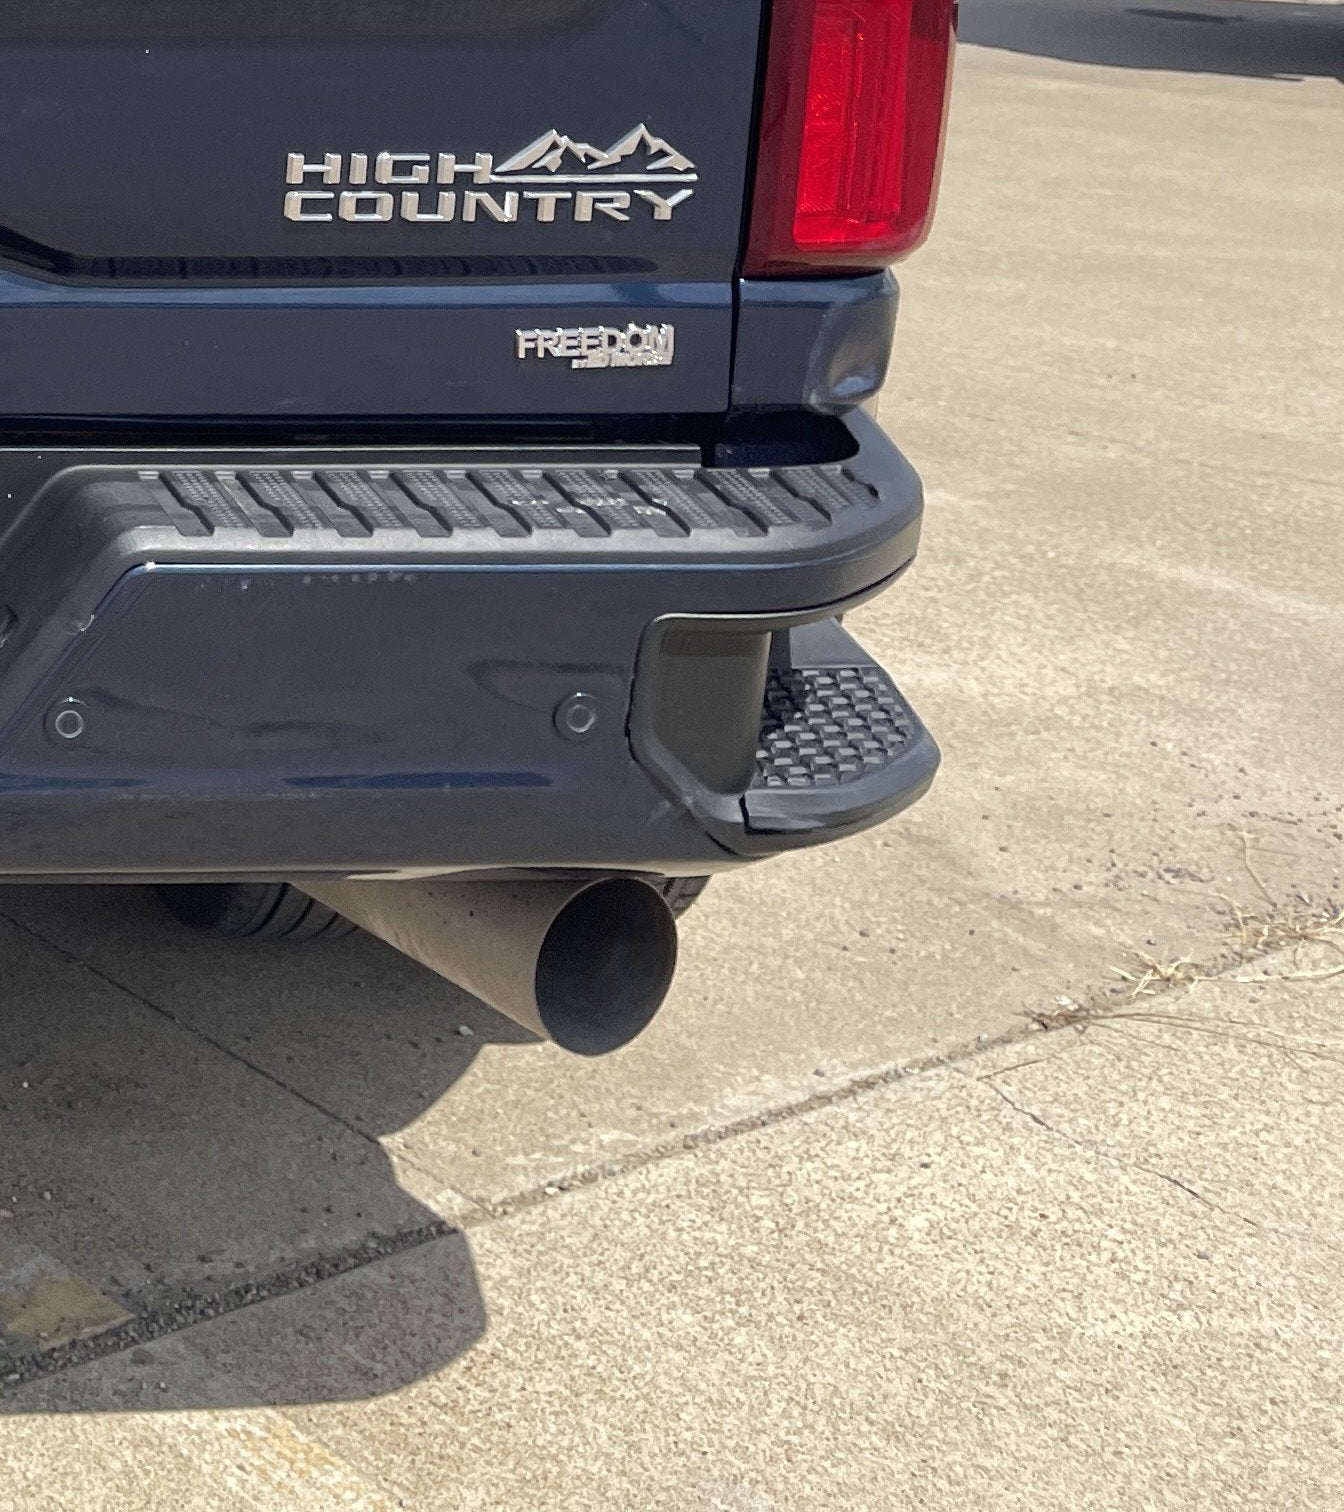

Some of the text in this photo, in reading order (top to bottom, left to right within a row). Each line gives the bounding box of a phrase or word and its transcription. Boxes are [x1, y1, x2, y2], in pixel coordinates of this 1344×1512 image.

[285, 152, 495, 185] HIGH
[284, 189, 695, 223] COUNTRY
[515, 322, 675, 359] FREEDOM
